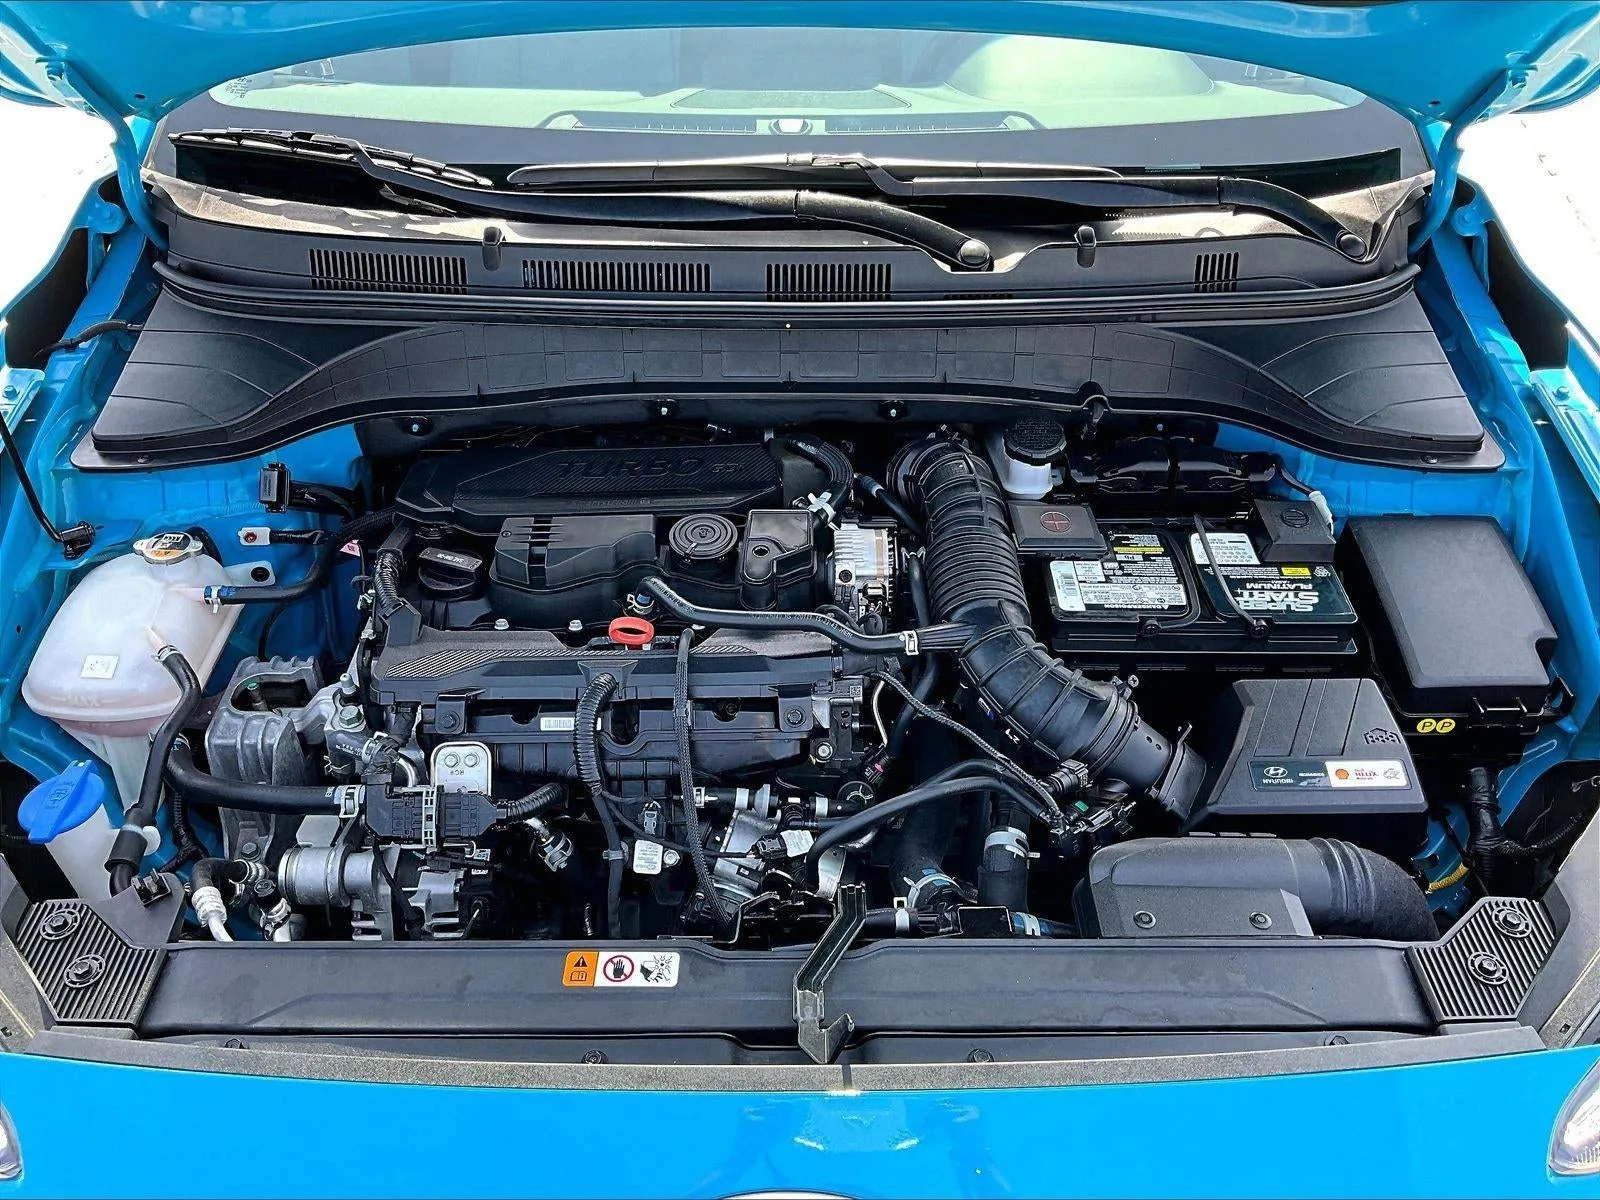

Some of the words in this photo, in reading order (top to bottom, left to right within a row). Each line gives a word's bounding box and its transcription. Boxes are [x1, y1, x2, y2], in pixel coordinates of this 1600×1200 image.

[557, 459, 704, 479] TURBO
[1235, 589, 1319, 604] START
[1239, 600, 1314, 612] SUPER
